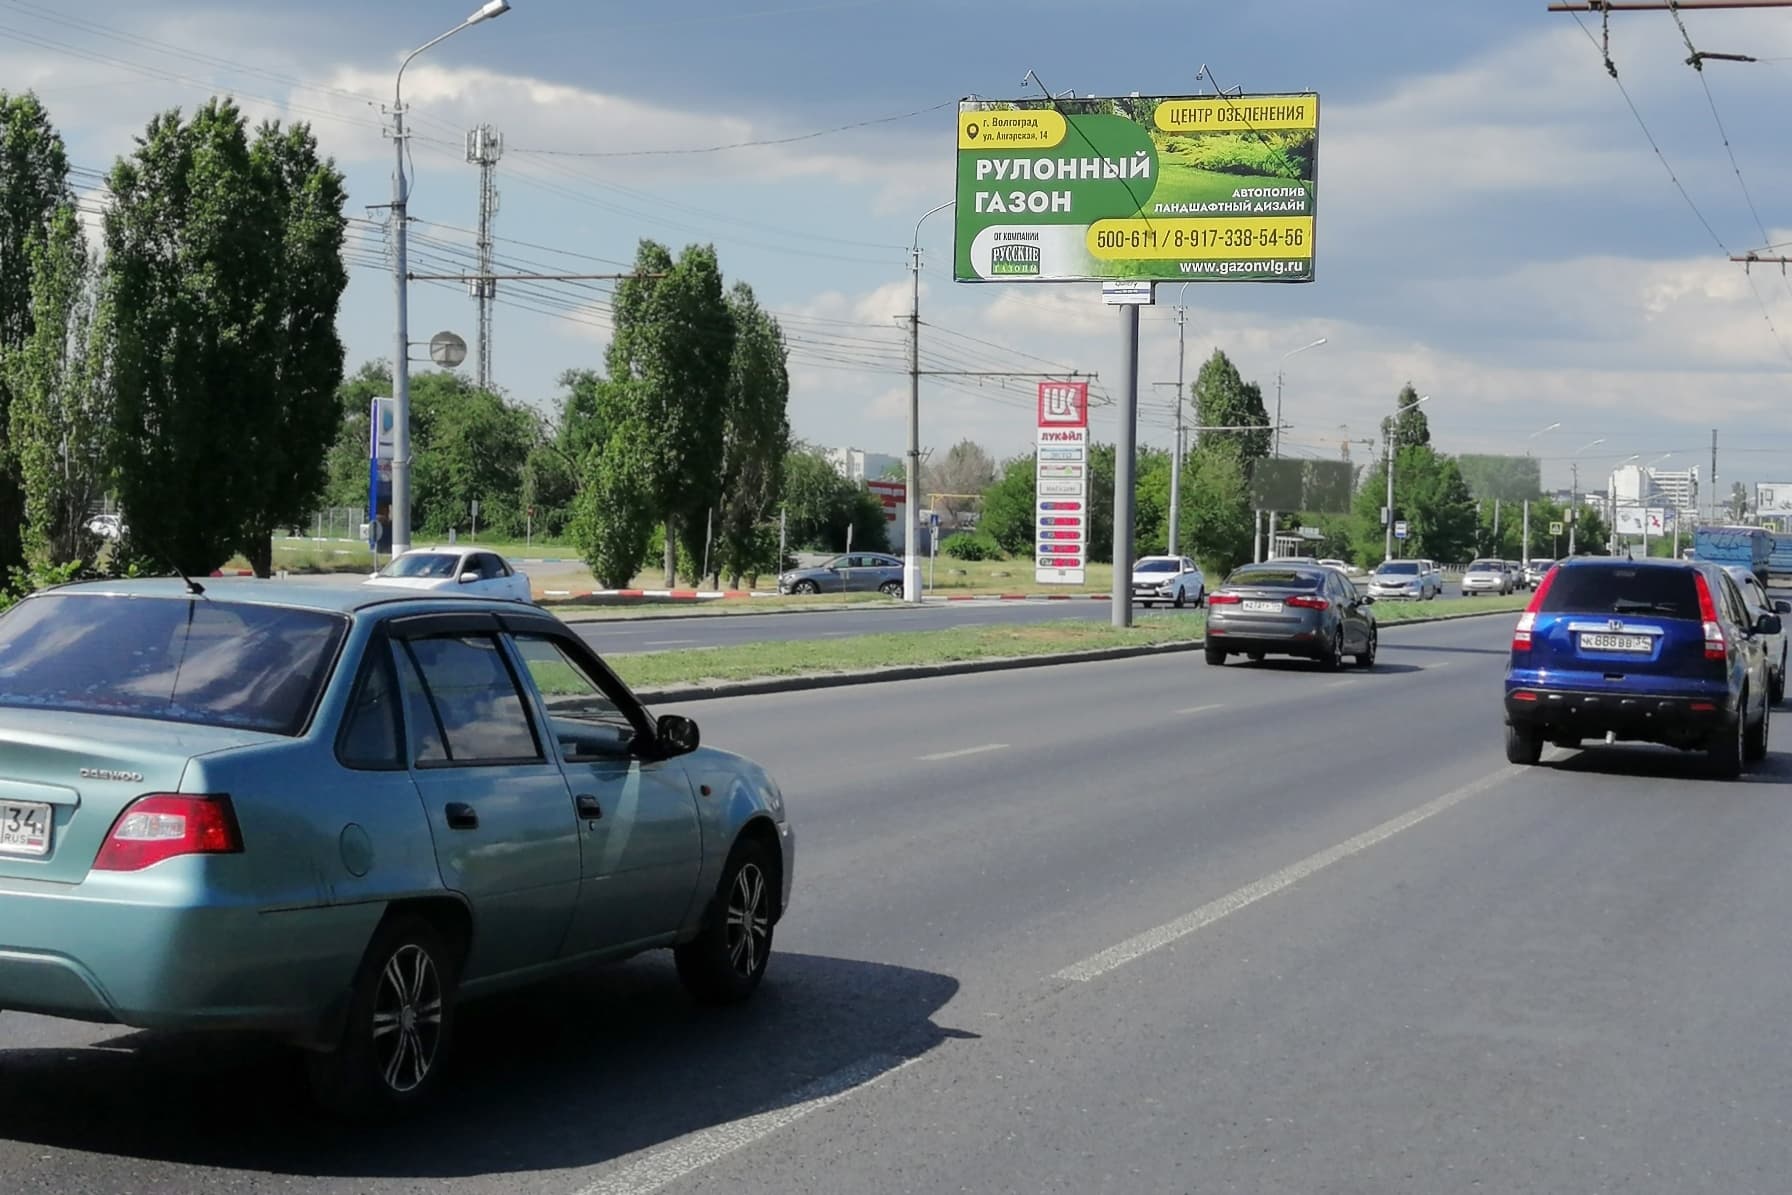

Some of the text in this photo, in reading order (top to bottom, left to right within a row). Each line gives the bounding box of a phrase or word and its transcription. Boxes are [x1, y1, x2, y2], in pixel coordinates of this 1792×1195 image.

[1170, 105, 1305, 124] ЦЕНТР ОЗЕЛЕНЕНИЯ
[983, 117, 1038, 128] г. Волгоград
[982, 134, 994, 142] ул.
[1040, 131, 1048, 140] 14
[975, 151, 1151, 181] РУЛОННЫЙ
[1232, 187, 1305, 198] АВТОПОЛИВ
[974, 191, 1072, 213] ГАЗОН
[1154, 199, 1305, 213] ЛАНДШАФТНЫЙ ДИЗАЙН
[993, 231, 1039, 241] ОТ КОМПАНИИ
[1097, 228, 1303, 248] 500-611 / 8-917-338-54-56
[1179, 260, 1303, 275] www.gazonvlg.ru
[80, 767, 144, 783] DAEWOO
[7, 807, 37, 835] 34
[4, 833, 27, 845] RUS
